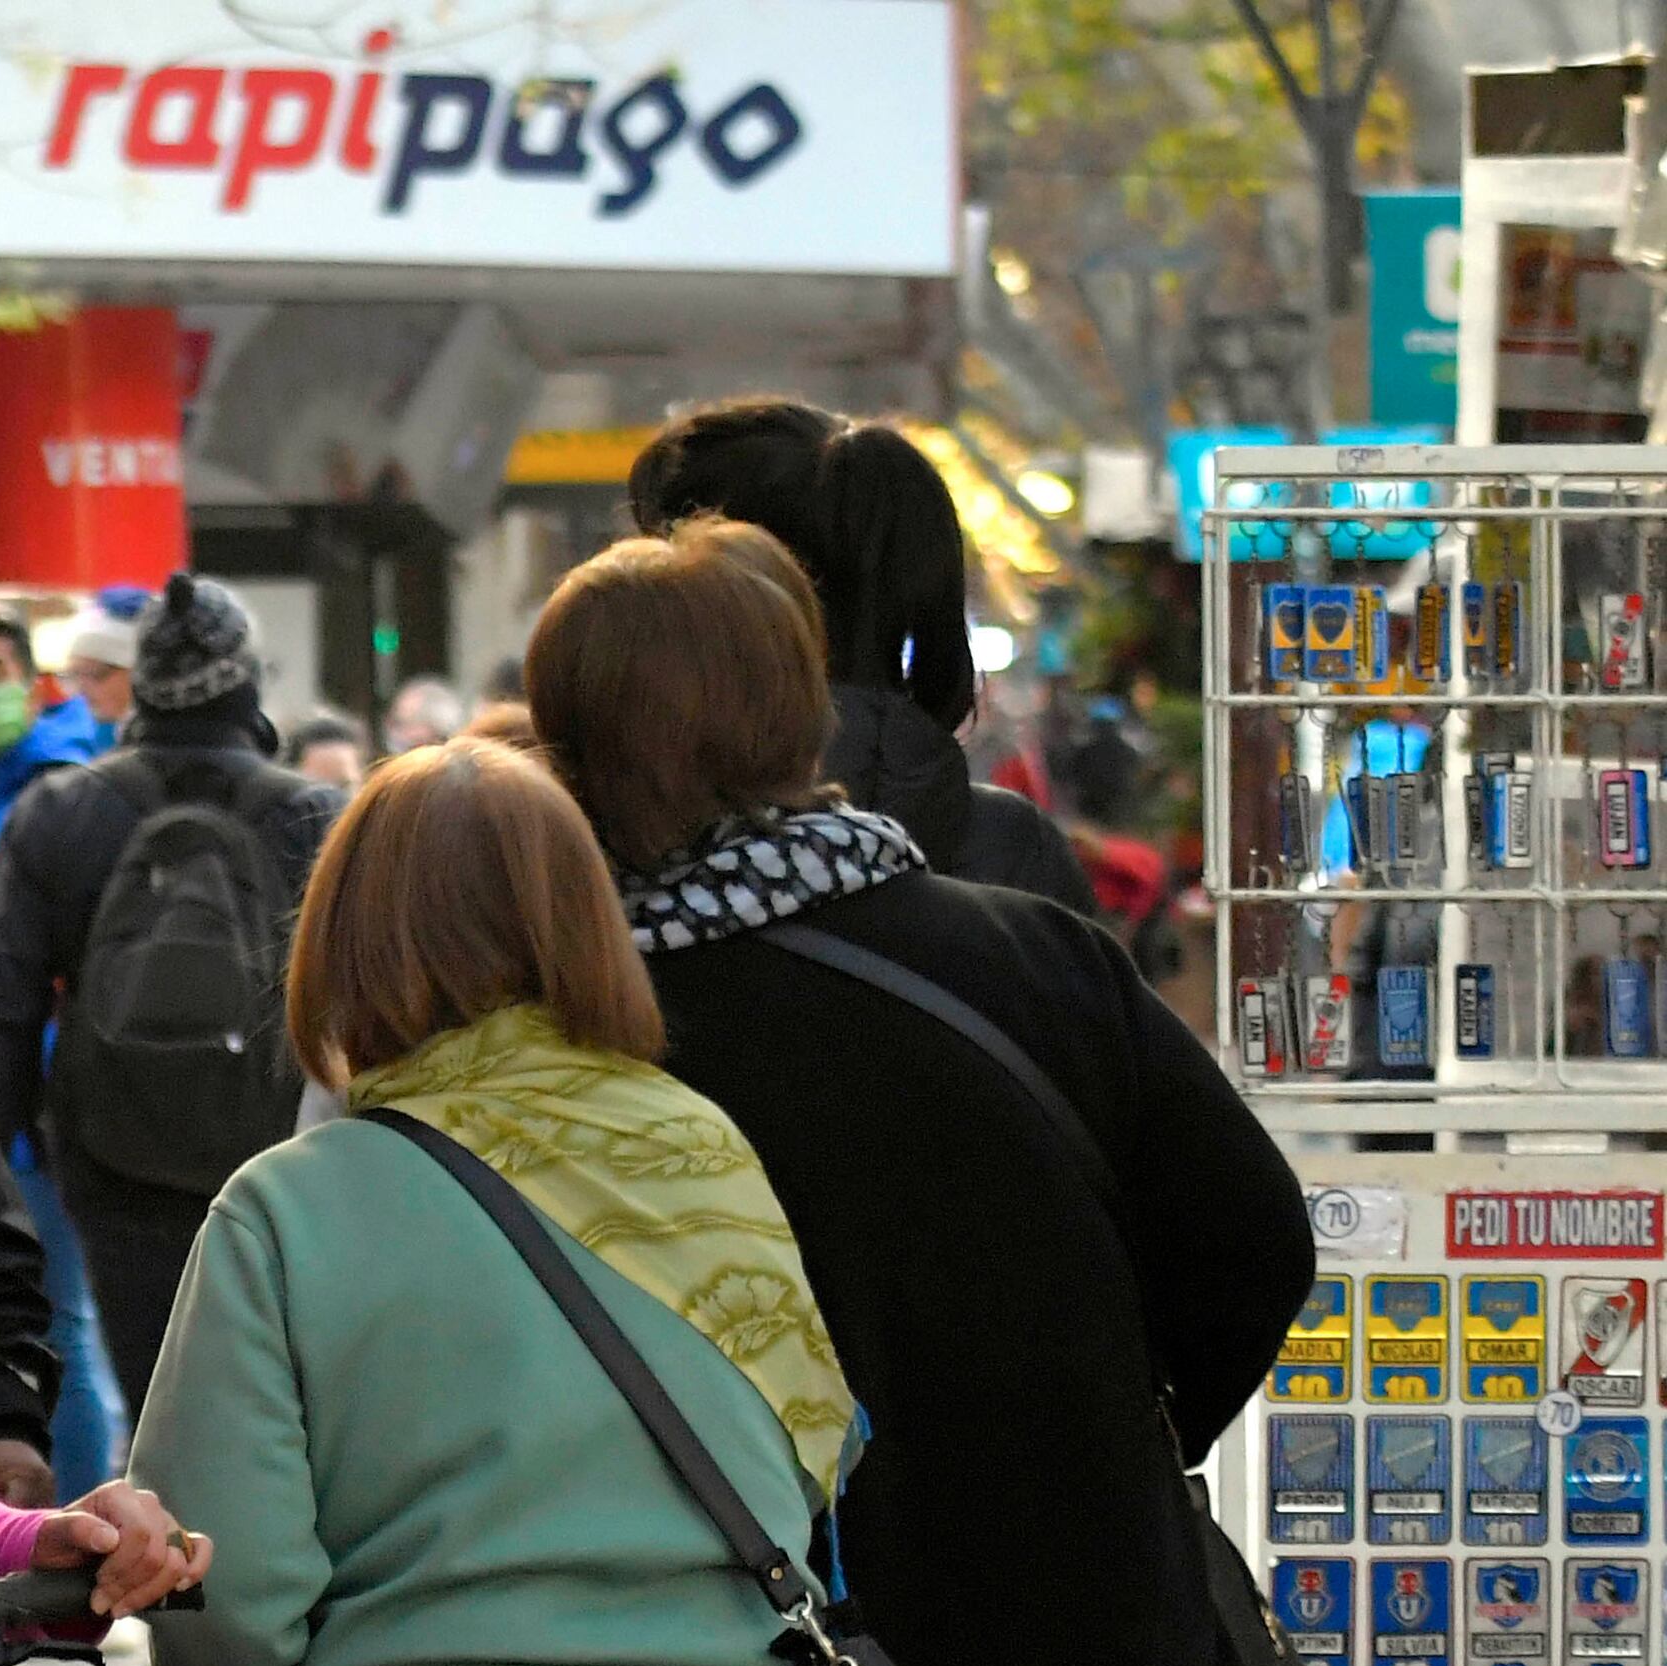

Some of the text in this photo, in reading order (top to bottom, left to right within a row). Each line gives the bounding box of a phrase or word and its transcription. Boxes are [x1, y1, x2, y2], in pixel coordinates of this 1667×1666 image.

[45, 28, 803, 215] rapipago
[1454, 1198, 1656, 1247] PEDI TU NOMBRE
[1476, 1342, 1528, 1360] OMAR
[1573, 1378, 1634, 1397] OSCAR
